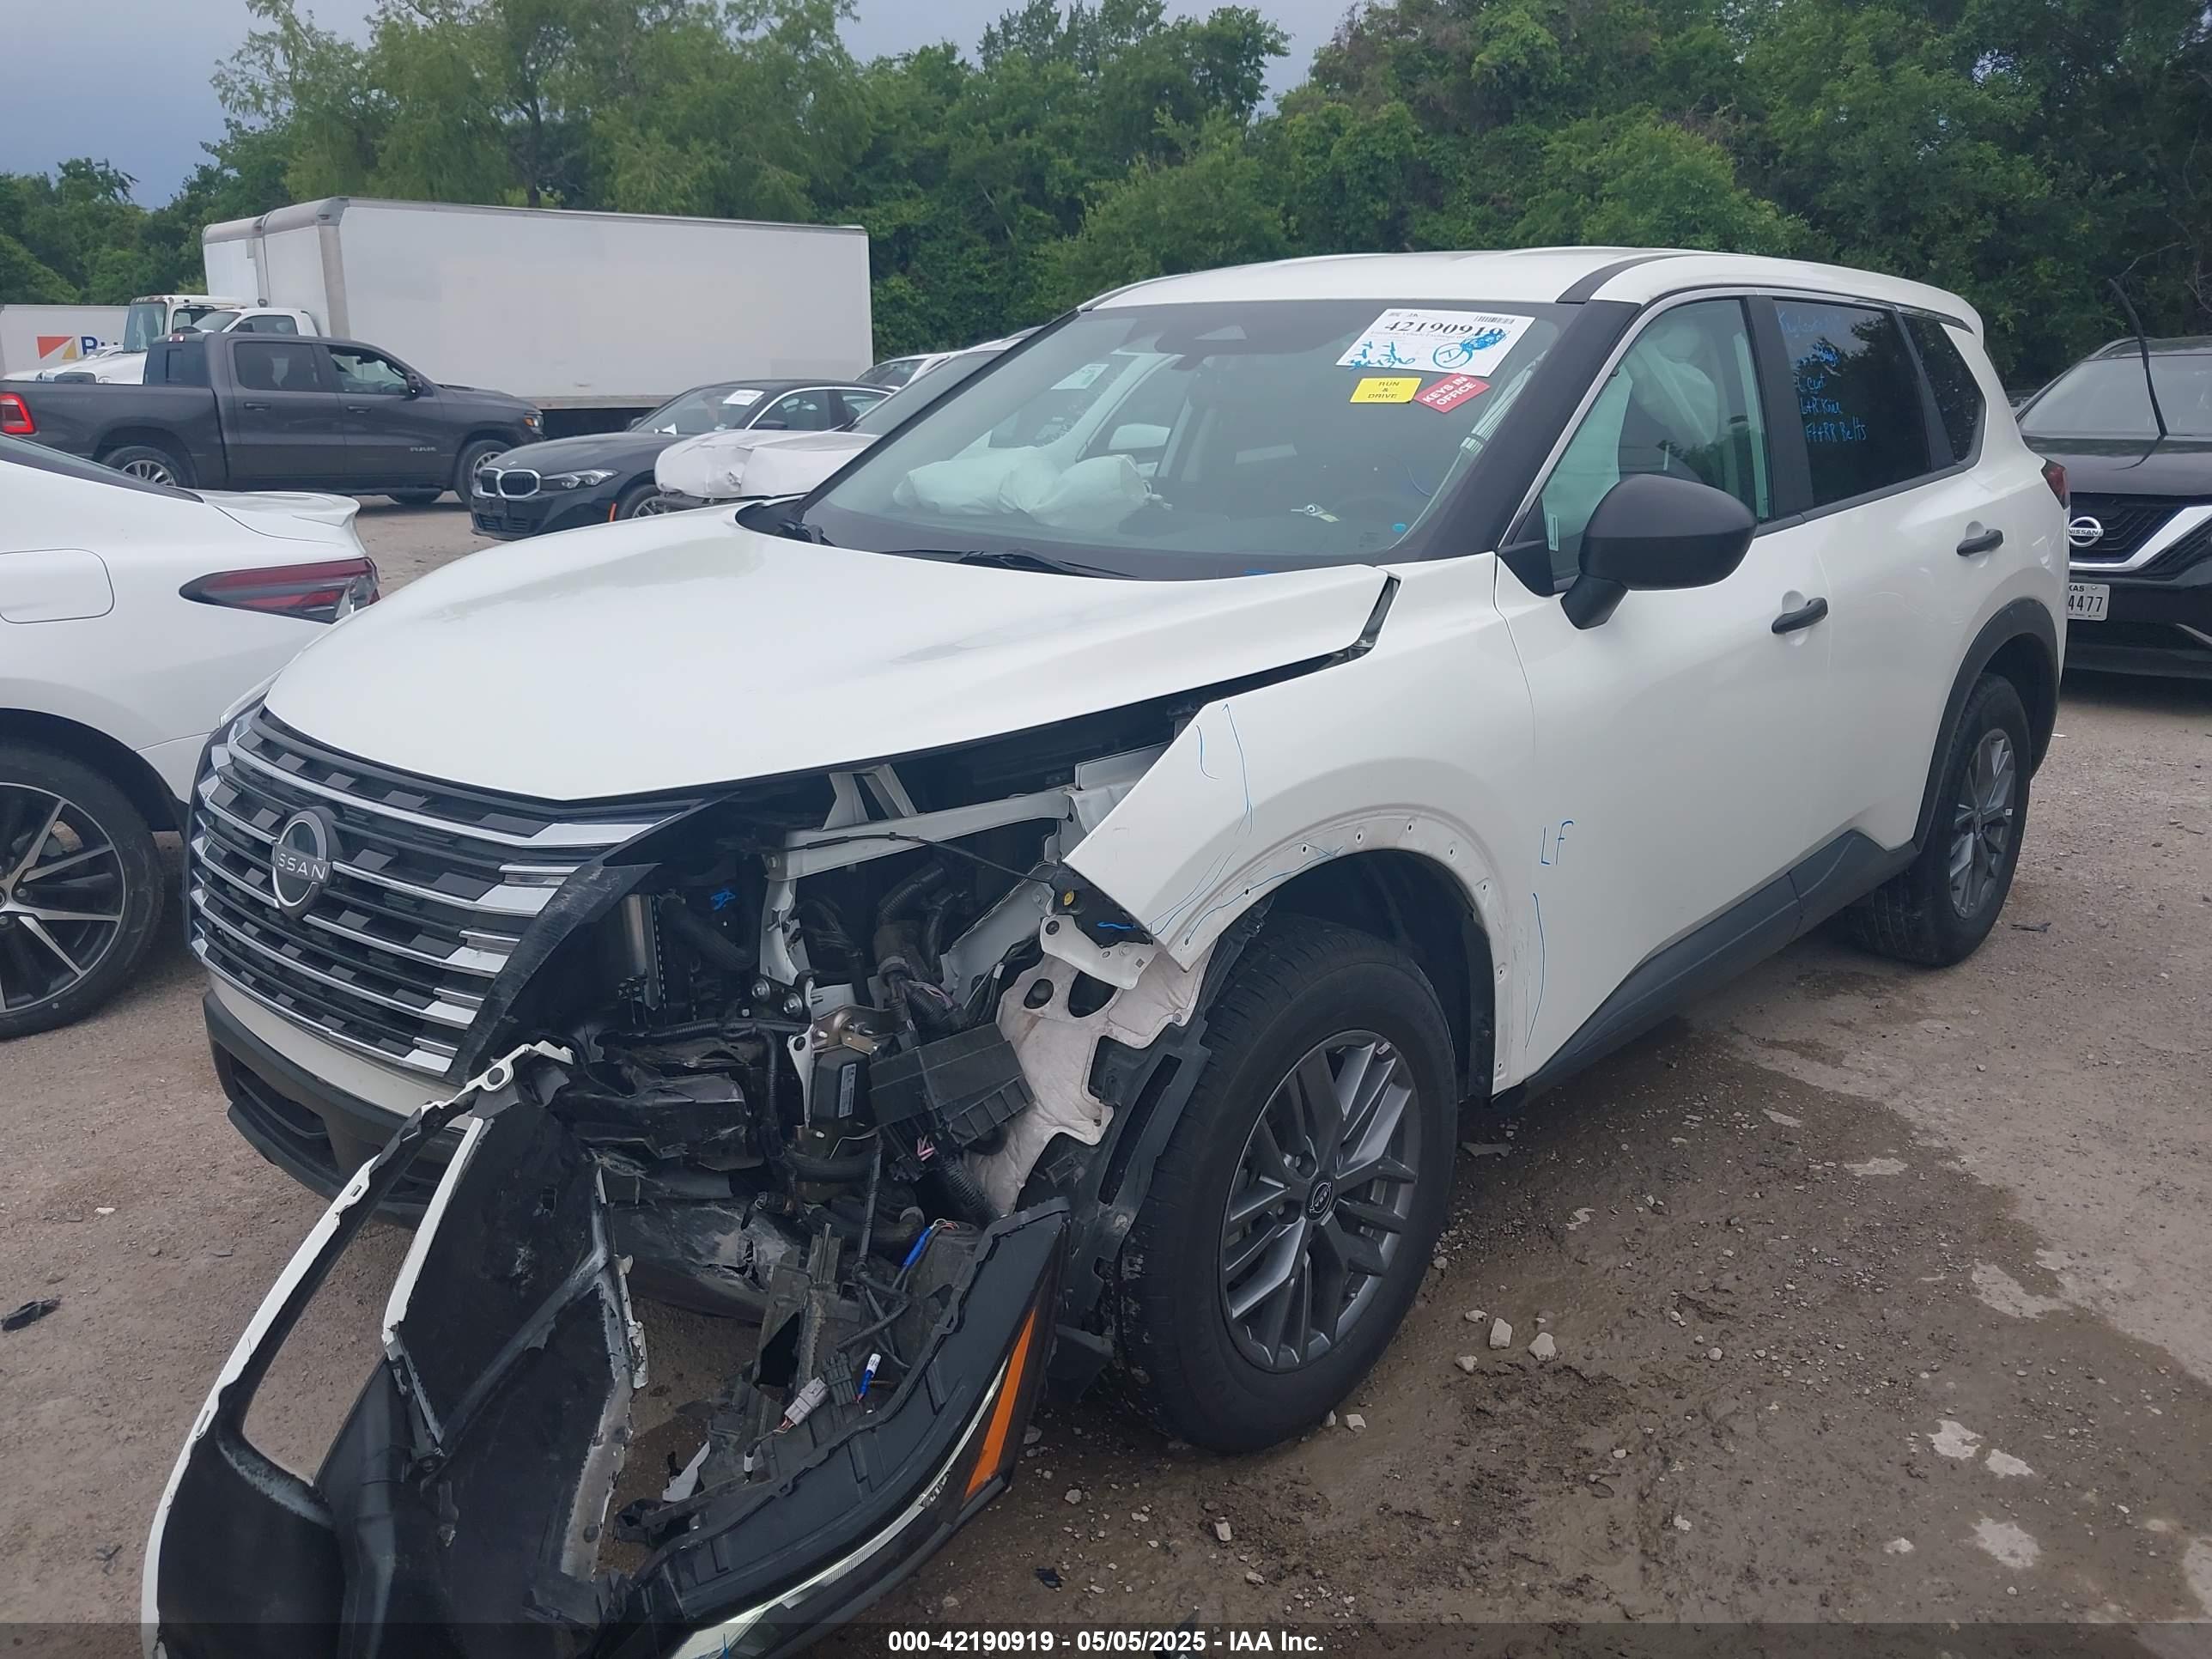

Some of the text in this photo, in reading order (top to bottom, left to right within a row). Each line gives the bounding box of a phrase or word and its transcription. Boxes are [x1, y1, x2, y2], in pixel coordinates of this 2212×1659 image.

[1422, 376, 1468, 403] KEYS IN
[1436, 382, 1477, 405] OFFICE
[2069, 528, 2099, 537] NISSAN
